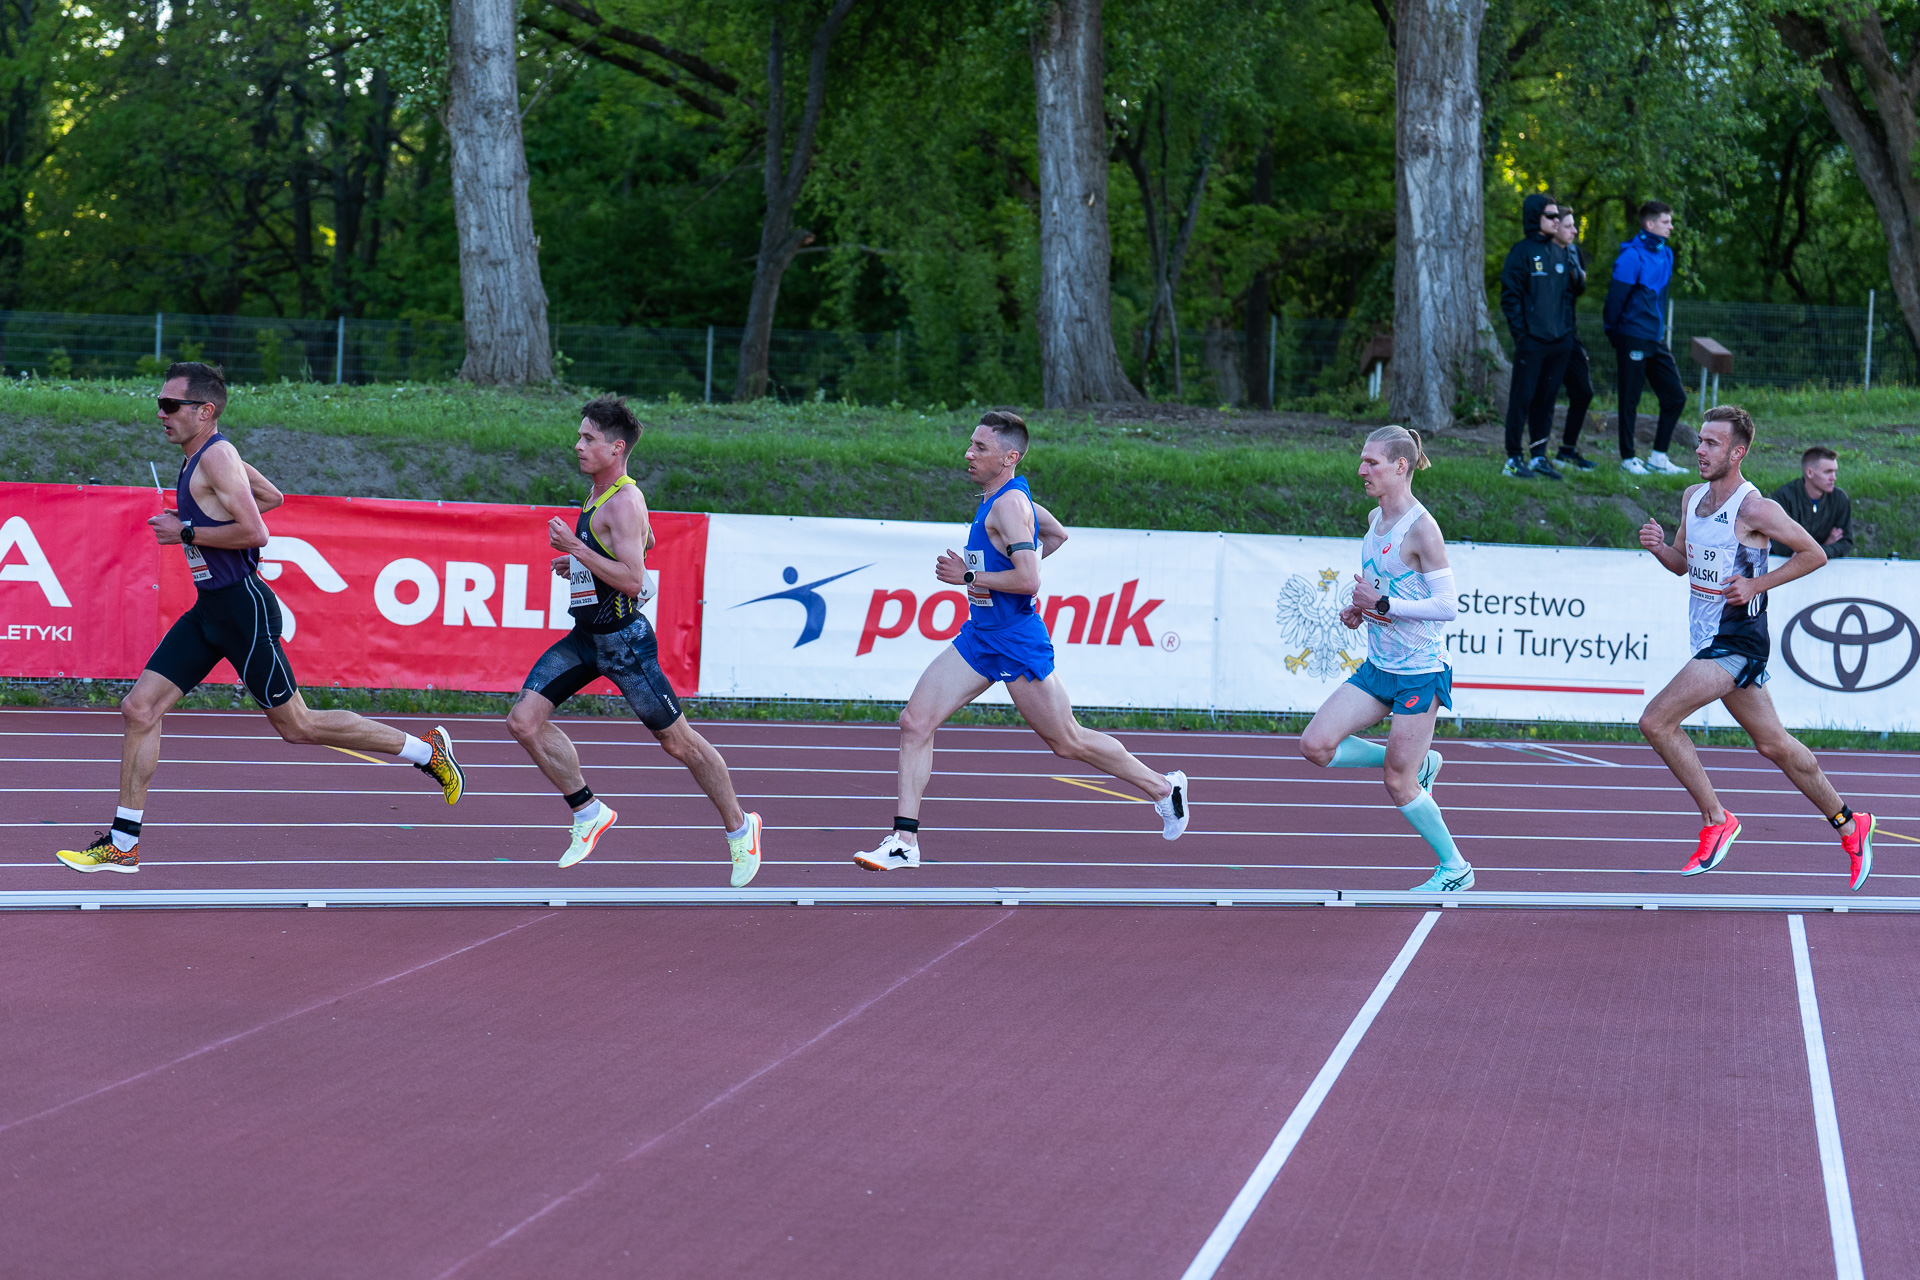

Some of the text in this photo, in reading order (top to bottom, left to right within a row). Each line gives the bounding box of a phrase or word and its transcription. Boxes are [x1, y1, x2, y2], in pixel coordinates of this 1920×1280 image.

[1704, 550, 1716, 561] 59
[570, 569, 592, 586] OWSKI
[1374, 578, 1380, 590] 2
[1688, 564, 1718, 583] KALSKI
[374, 557, 660, 631] ORL
[1457, 588, 1585, 618] sterstwo
[856, 578, 1166, 657] ponik
[1445, 628, 1649, 665] rtu i Turystyki
